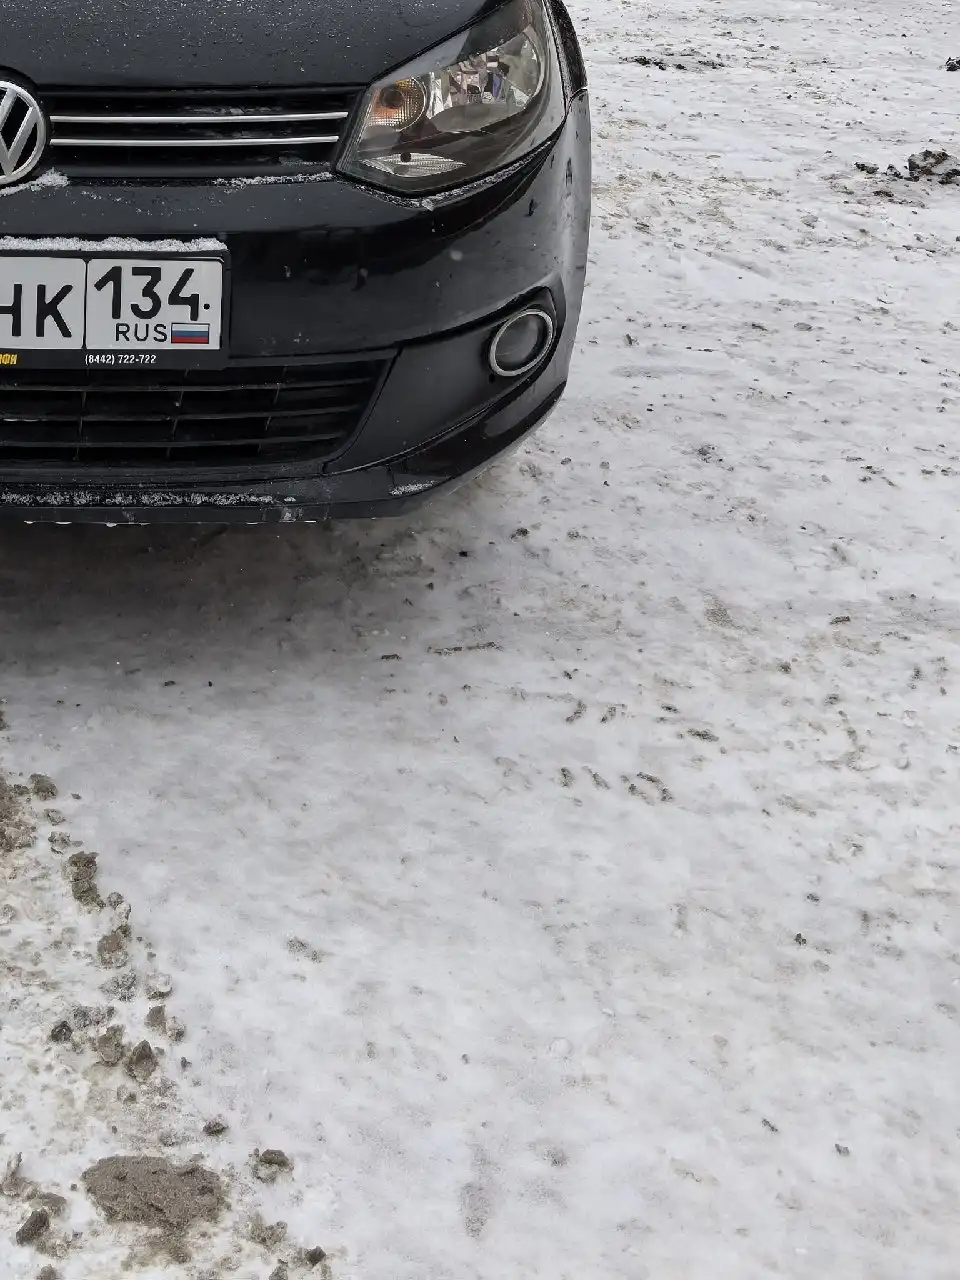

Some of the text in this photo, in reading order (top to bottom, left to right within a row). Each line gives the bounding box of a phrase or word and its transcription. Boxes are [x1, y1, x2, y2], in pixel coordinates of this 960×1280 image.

[93, 266, 200, 322] 134
[115, 322, 168, 342] RUS
[84, 354, 157, 365] (8442) 722-722
